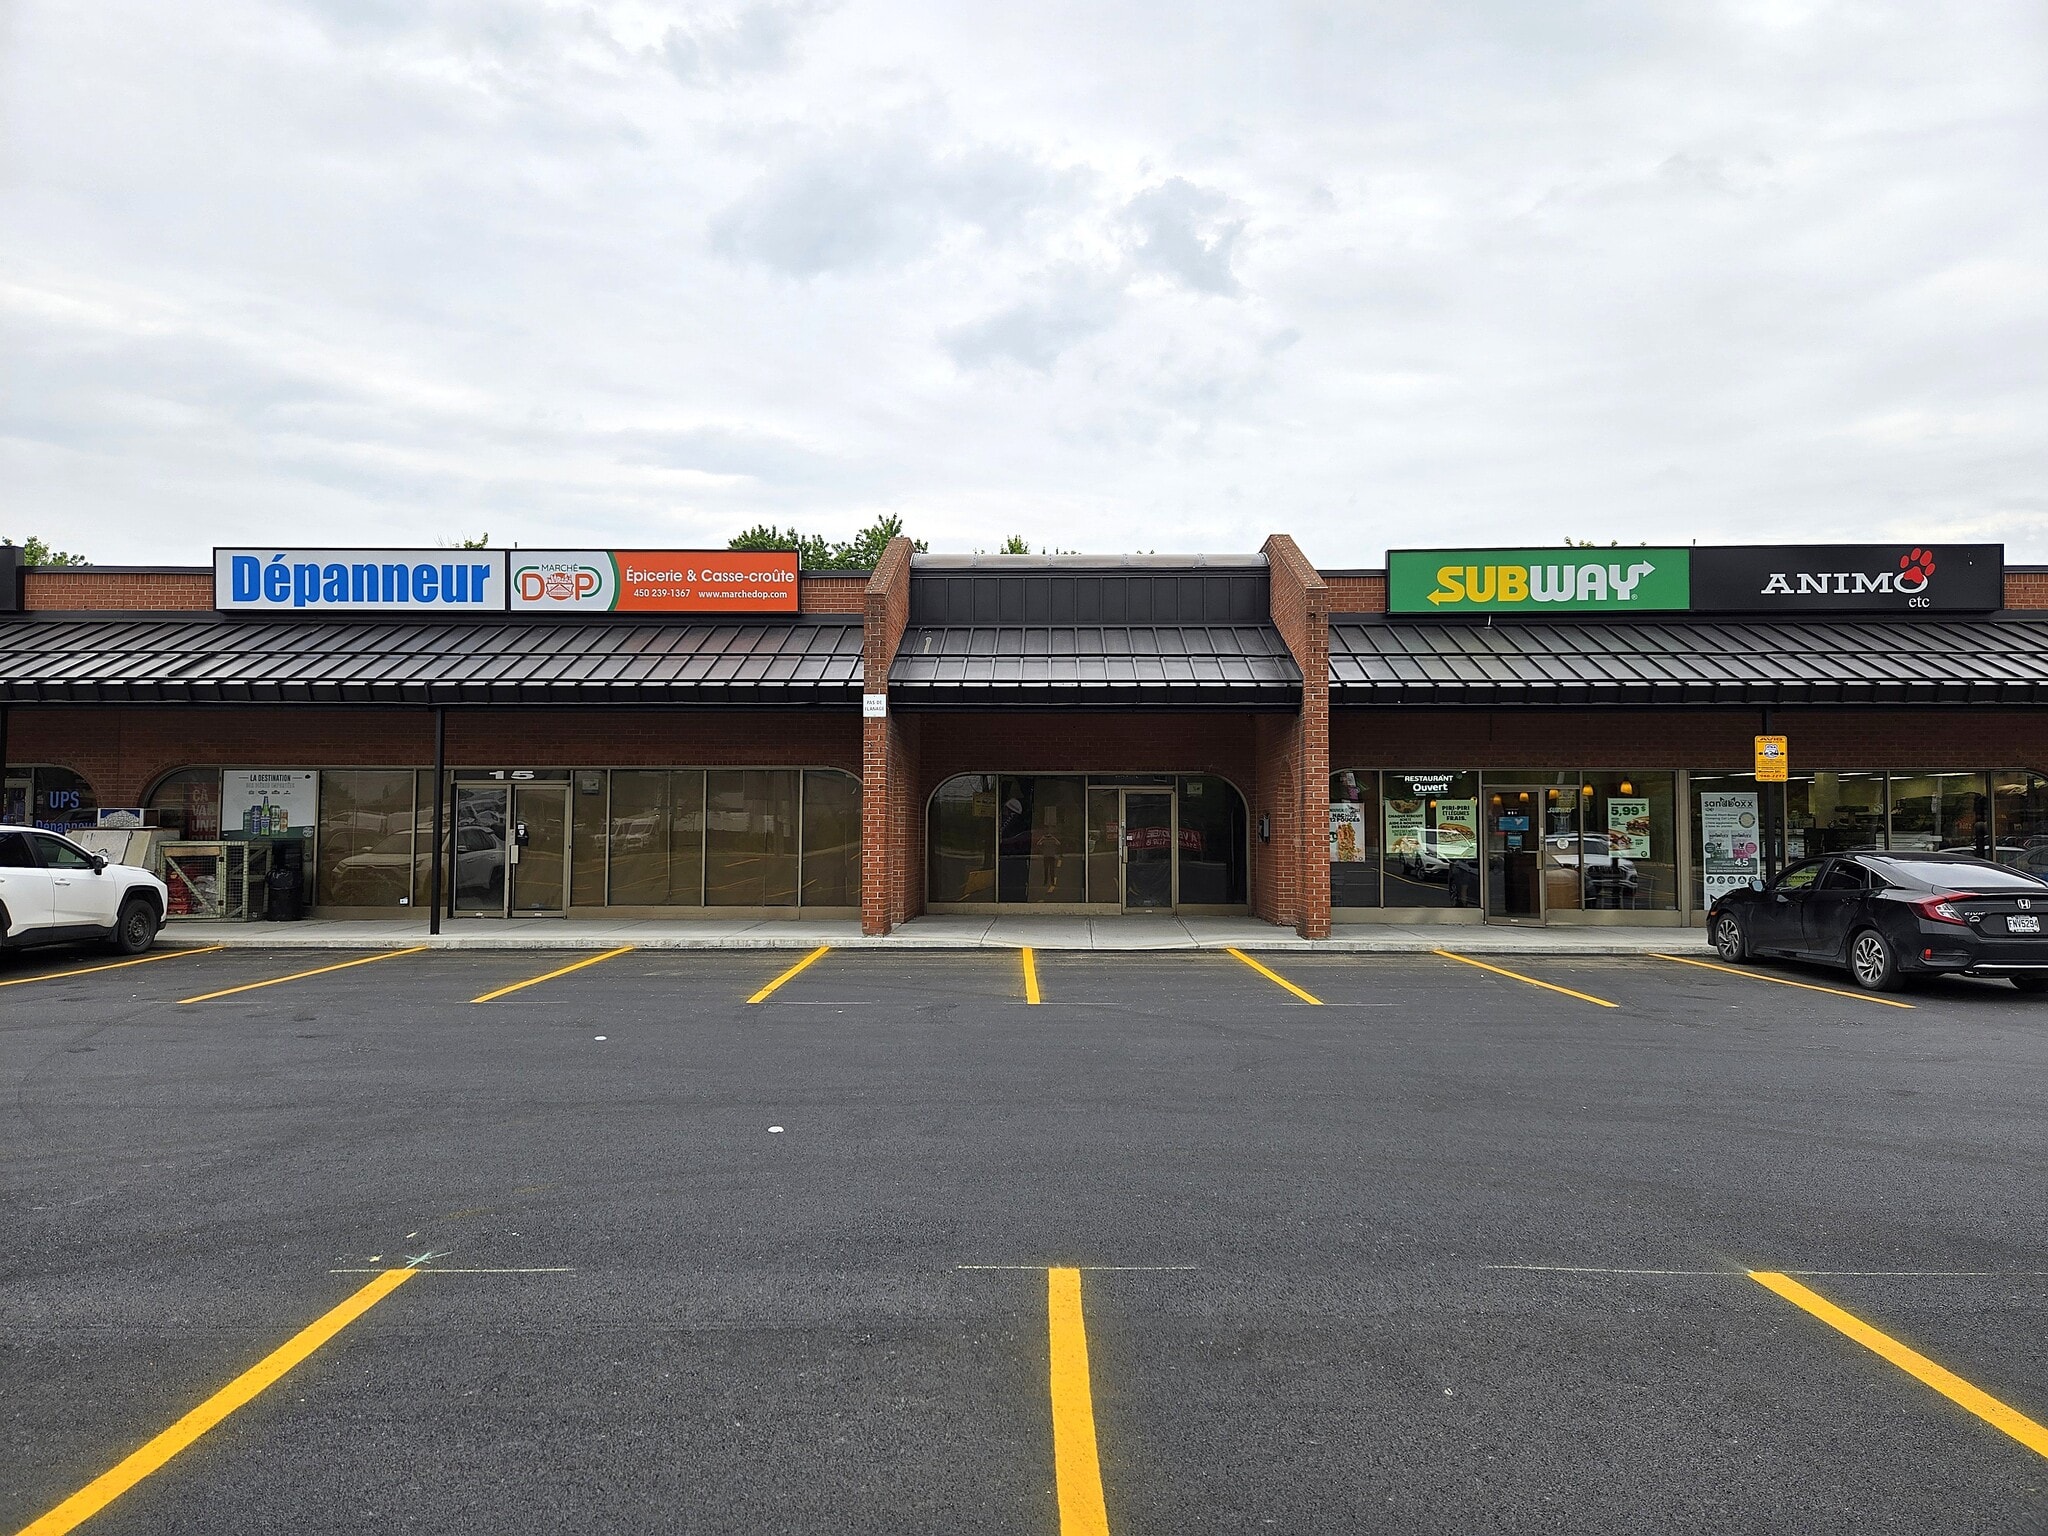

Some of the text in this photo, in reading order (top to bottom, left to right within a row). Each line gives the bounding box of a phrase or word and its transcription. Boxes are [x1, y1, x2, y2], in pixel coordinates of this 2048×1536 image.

[541, 563, 579, 572] MARCHÉ
[232, 554, 490, 607] Dépanneur
[626, 566, 795, 583] Épicerie & Casse-croûte
[1427, 560, 1656, 606] SUBWAY
[1760, 571, 1929, 594] ANIMO
[633, 588, 788, 600] 450 239-1367 www.marchedop.com
[1908, 596, 1930, 608] etc
[249, 774, 291, 782] LA DESTINATION
[488, 770, 535, 780] 15
[1412, 783, 1449, 792] Ouvert
[49, 790, 80, 809] UPS
[1610, 806, 1640, 816] 5,99
[191, 819, 217, 832] UNE
